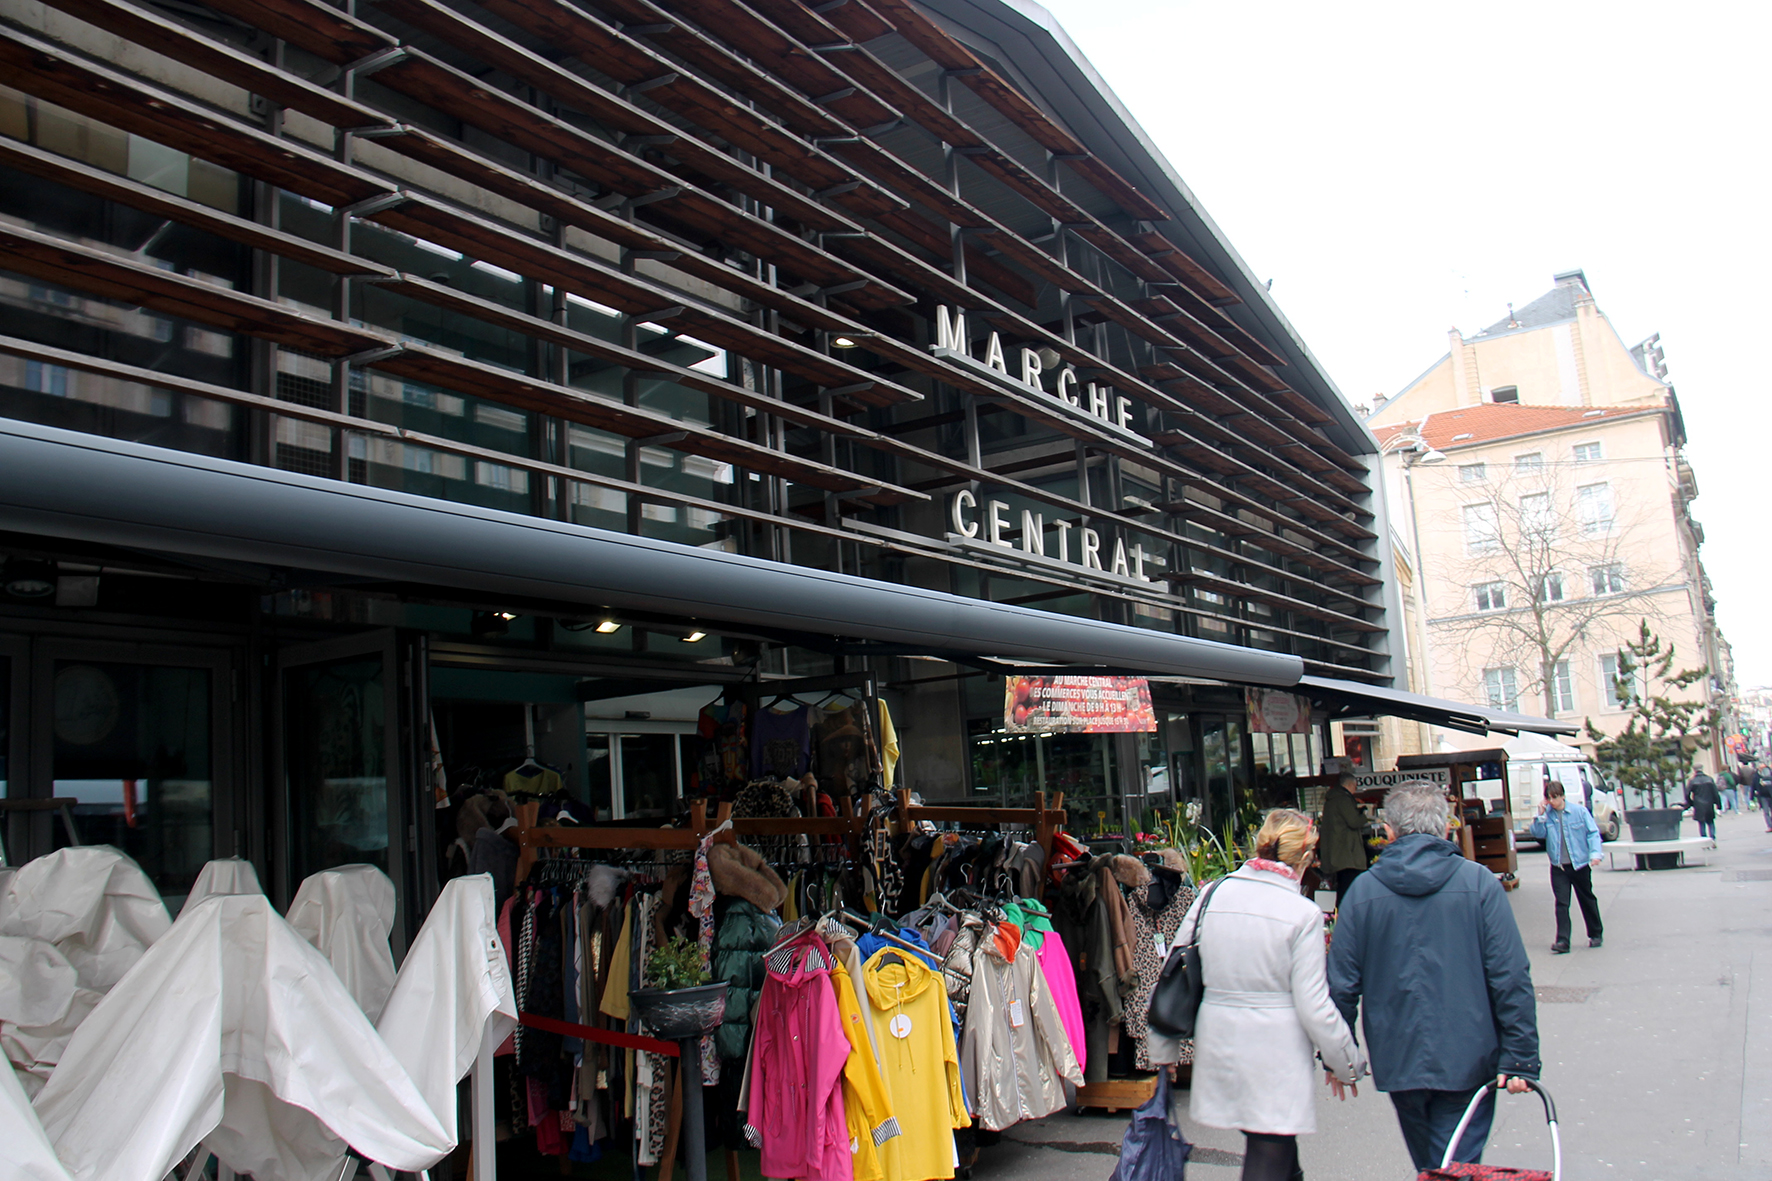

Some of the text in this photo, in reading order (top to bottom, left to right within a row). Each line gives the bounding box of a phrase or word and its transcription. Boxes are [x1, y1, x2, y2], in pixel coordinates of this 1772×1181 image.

[936, 304, 1135, 434] MARCHE
[951, 489, 1150, 583] CENTRAL
[1053, 675, 1064, 685] AU
[1088, 676, 1113, 688] CENTRAL
[1042, 687, 1080, 699] COMMERCES
[1081, 689, 1098, 700] VOUS
[1042, 700, 1051, 711] LE
[1051, 701, 1086, 712] DIMANCHE
[1086, 702, 1095, 712] DE
[1109, 702, 1117, 713] 13
[1356, 771, 1446, 787] BOUQUINISTE
